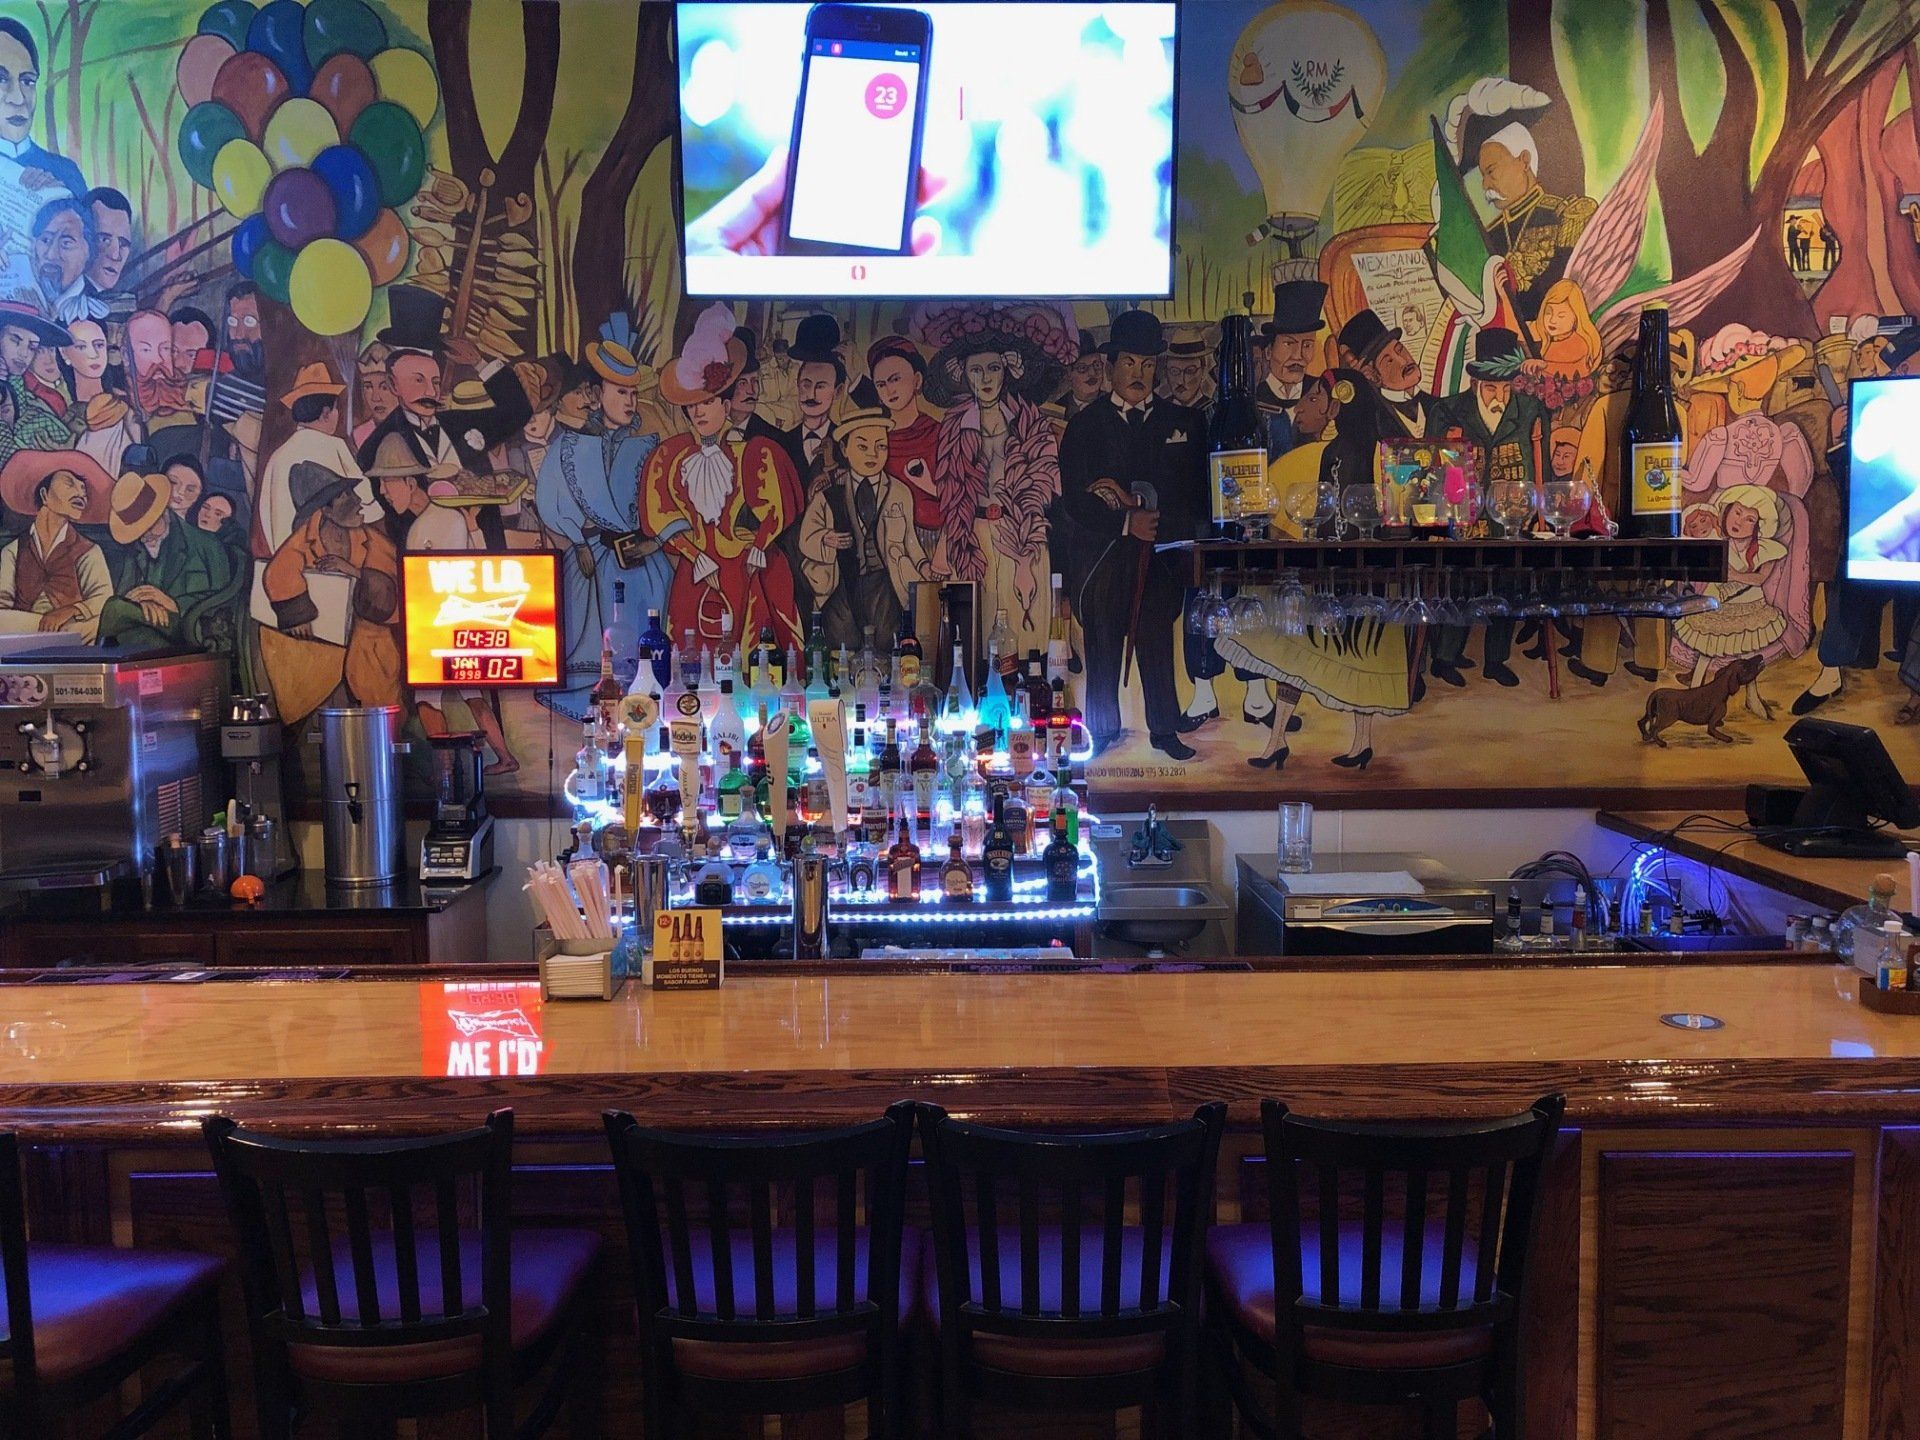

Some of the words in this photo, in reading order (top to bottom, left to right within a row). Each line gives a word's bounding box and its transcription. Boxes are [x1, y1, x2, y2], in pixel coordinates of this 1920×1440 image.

[1306, 60, 1328, 78] RM
[873, 86, 898, 105] 23
[428, 560, 477, 593] WE
[456, 631, 507, 648] 04:38
[451, 658, 479, 669] JAN
[486, 658, 518, 679] 02
[453, 670, 482, 680] 1998
[712, 732, 741, 742] MALIBU
[1053, 732, 1067, 753] 7
